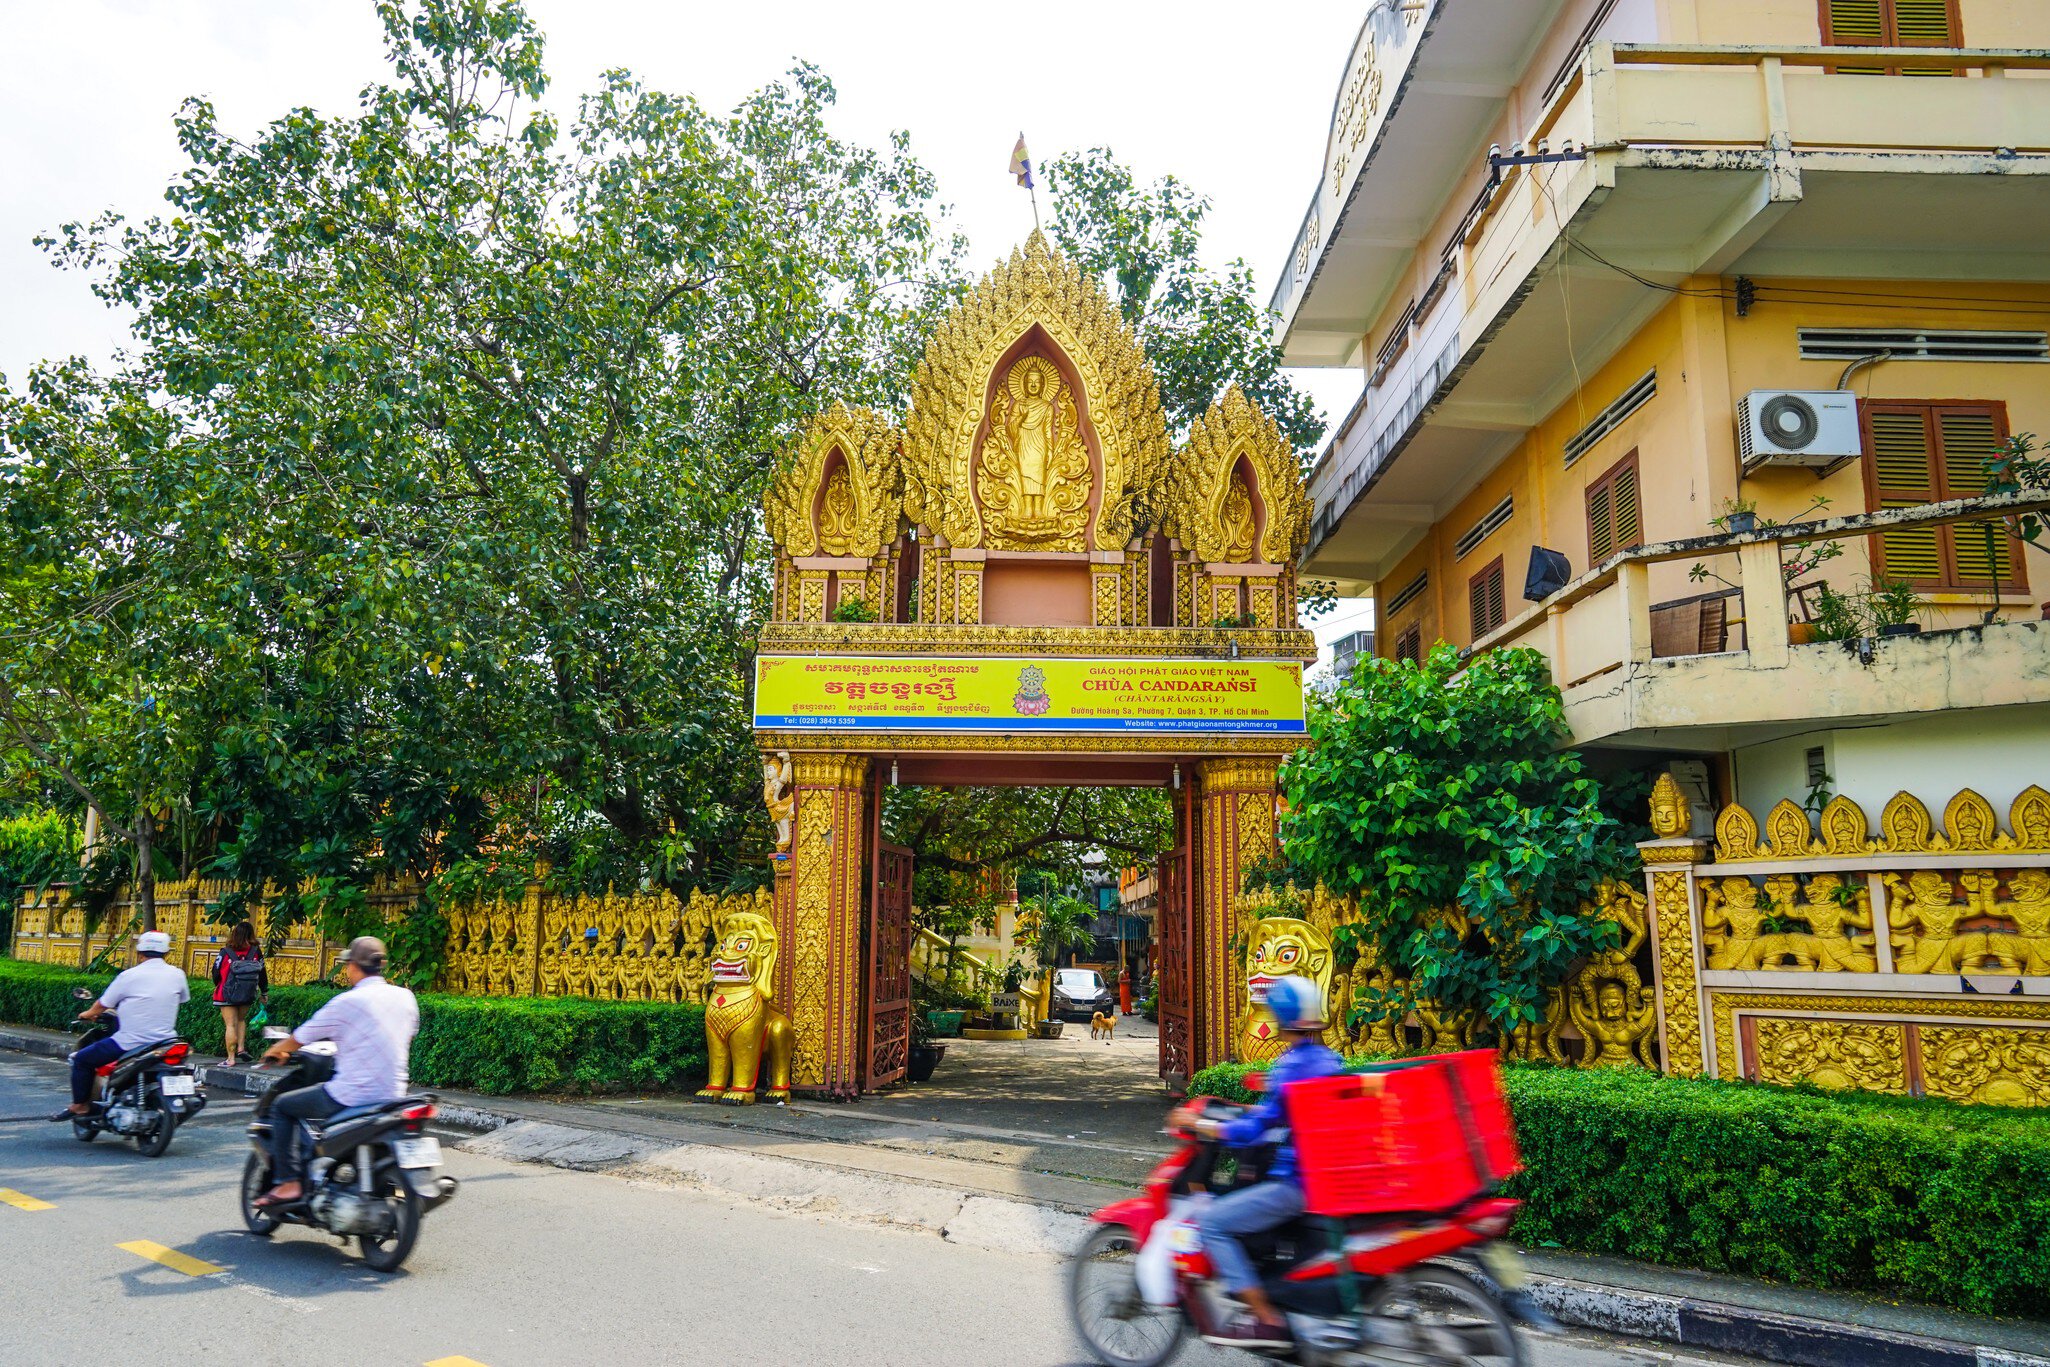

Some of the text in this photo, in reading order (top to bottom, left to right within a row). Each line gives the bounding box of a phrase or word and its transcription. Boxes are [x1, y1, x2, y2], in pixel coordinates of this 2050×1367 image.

[1089, 667, 1116, 675] GIÁO
[1118, 667, 1137, 676] HỘI
[1140, 667, 1168, 676] PHẬT
[1171, 667, 1197, 676] GIÁO
[1200, 667, 1223, 677] VIỆT
[1082, 677, 1134, 691] CHÙA
[1071, 707, 1094, 715] Đường
[1097, 707, 1120, 715] Hoàng
[1137, 707, 1165, 715] Phường
[1177, 708, 1196, 716] Quận
[1198, 708, 1206, 716] 3,
[1208, 708, 1221, 716] TP.
[799, 717, 818, 725] (028)
[1158, 720, 1278, 729] www.phatgiaonamtongkhmer.org
